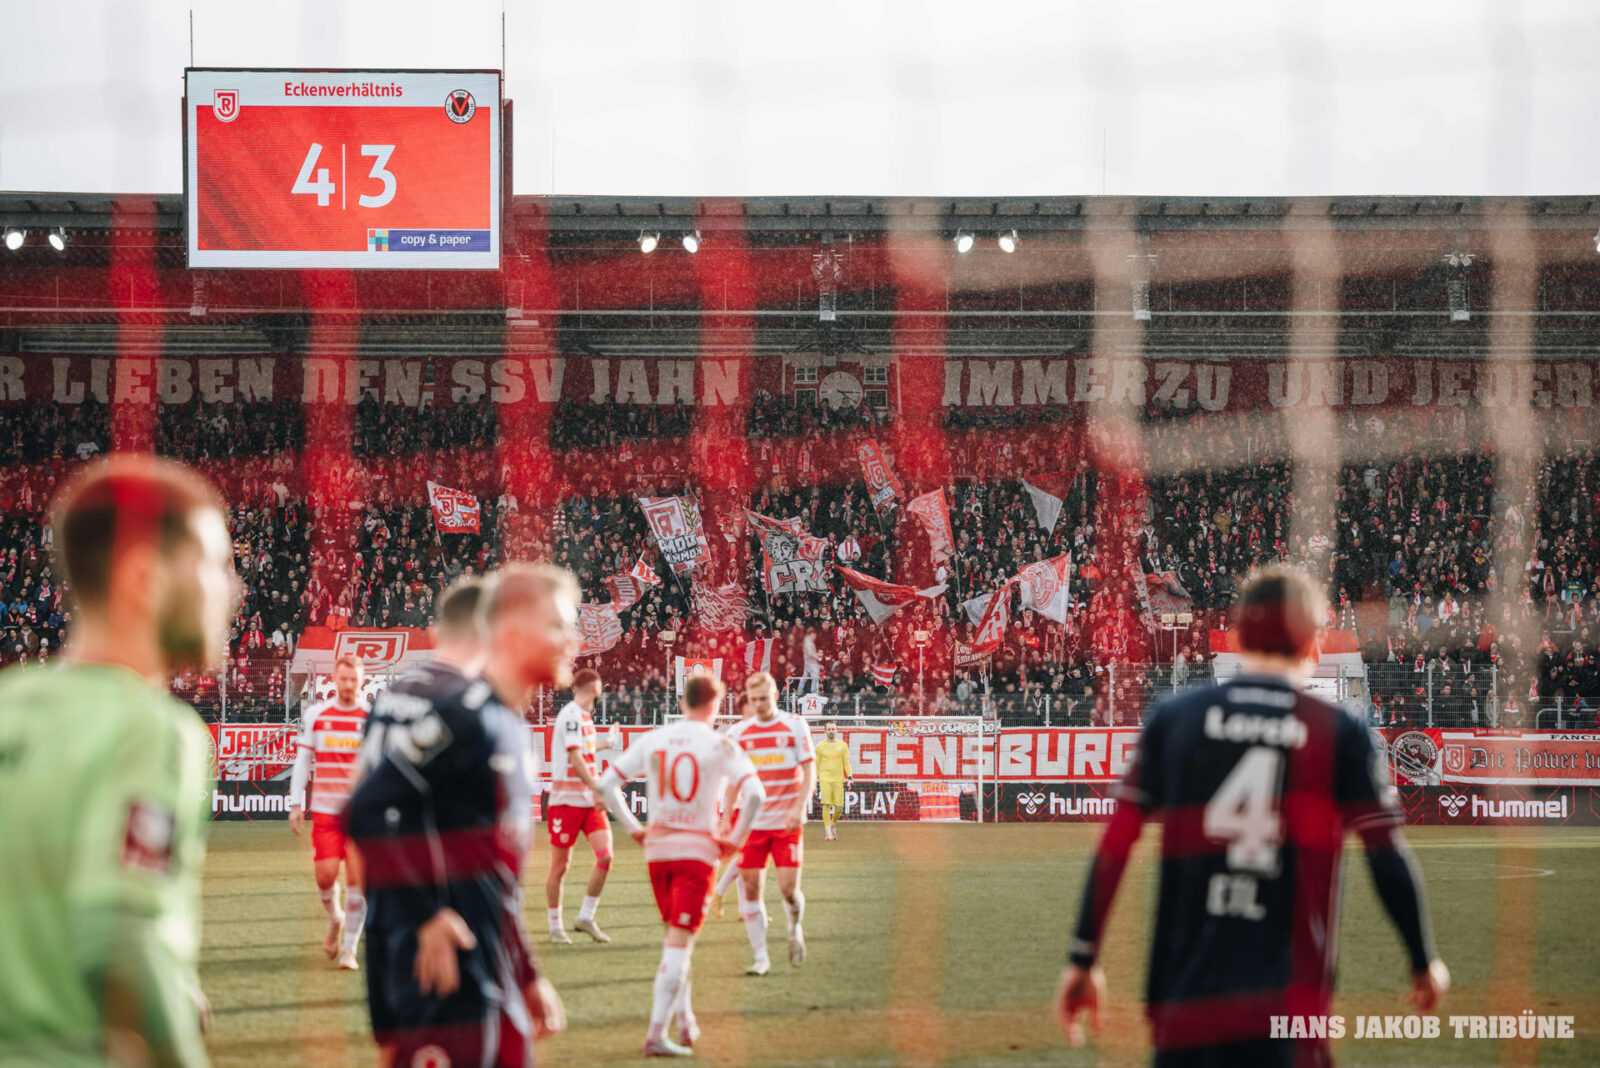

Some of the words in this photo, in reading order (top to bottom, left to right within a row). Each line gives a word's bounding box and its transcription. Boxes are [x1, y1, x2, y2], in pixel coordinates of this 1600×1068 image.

[284, 82, 403, 98] Eckenverhältnis
[291, 142, 336, 206] 4
[358, 144, 397, 208] 3
[401, 235, 426, 247] copy
[429, 234, 437, 245] &
[440, 234, 471, 247] paper
[51, 357, 276, 405] LIEBEN
[302, 358, 422, 407] DEN
[450, 358, 566, 405] SSV
[589, 358, 741, 406] JAHN
[1266, 360, 1389, 408] UND
[1469, 746, 1506, 769] Die
[1512, 746, 1579, 774] Power
[652, 749, 700, 803] 10
[844, 791, 900, 815] PLAY
[1049, 793, 1117, 815] humm
[1203, 746, 1286, 880] 4
[1471, 794, 1568, 818] hummel
